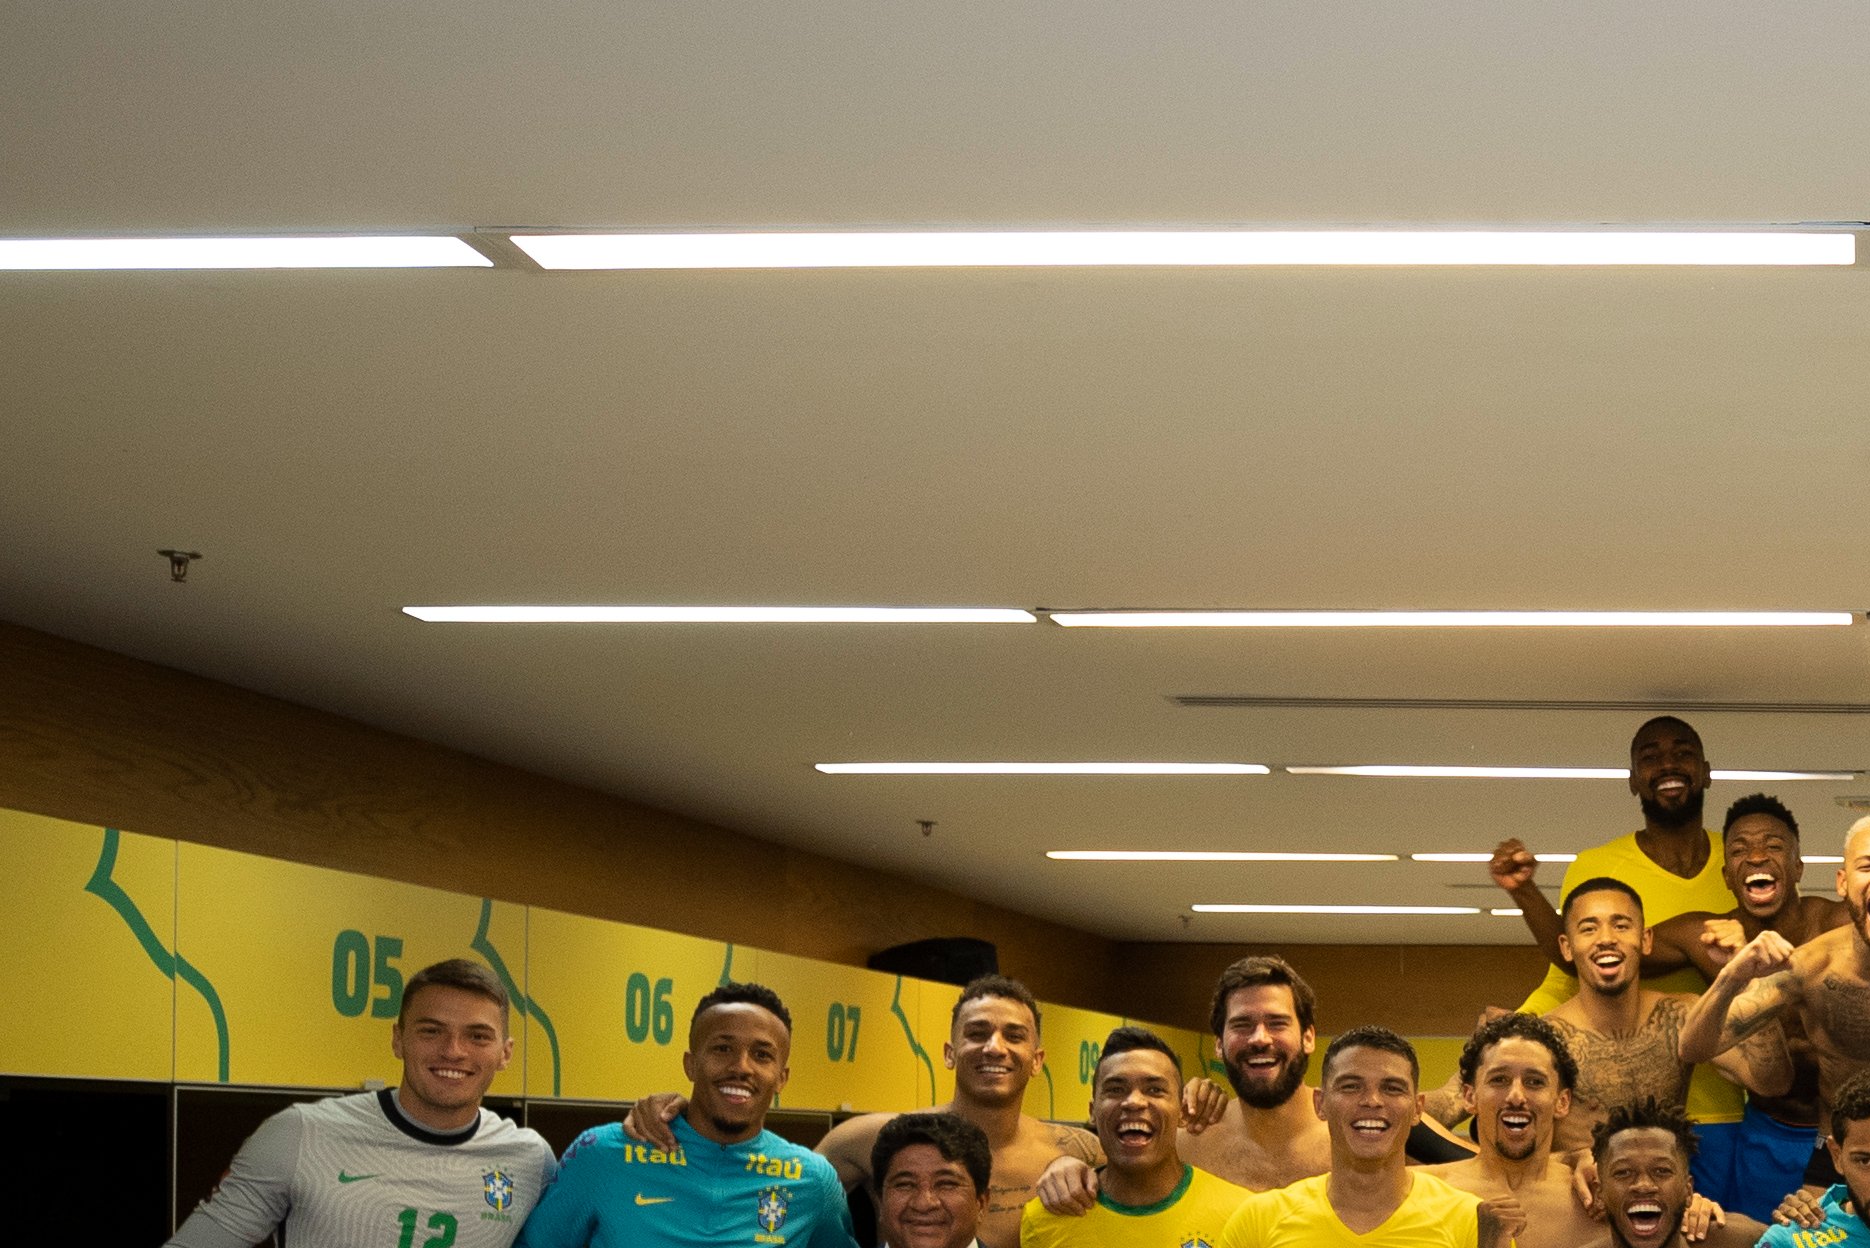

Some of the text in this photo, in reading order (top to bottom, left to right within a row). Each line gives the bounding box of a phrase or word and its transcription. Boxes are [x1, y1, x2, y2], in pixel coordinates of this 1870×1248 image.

[332, 929, 405, 1020] 05
[625, 972, 674, 1046] 06
[826, 1002, 861, 1063] 07
